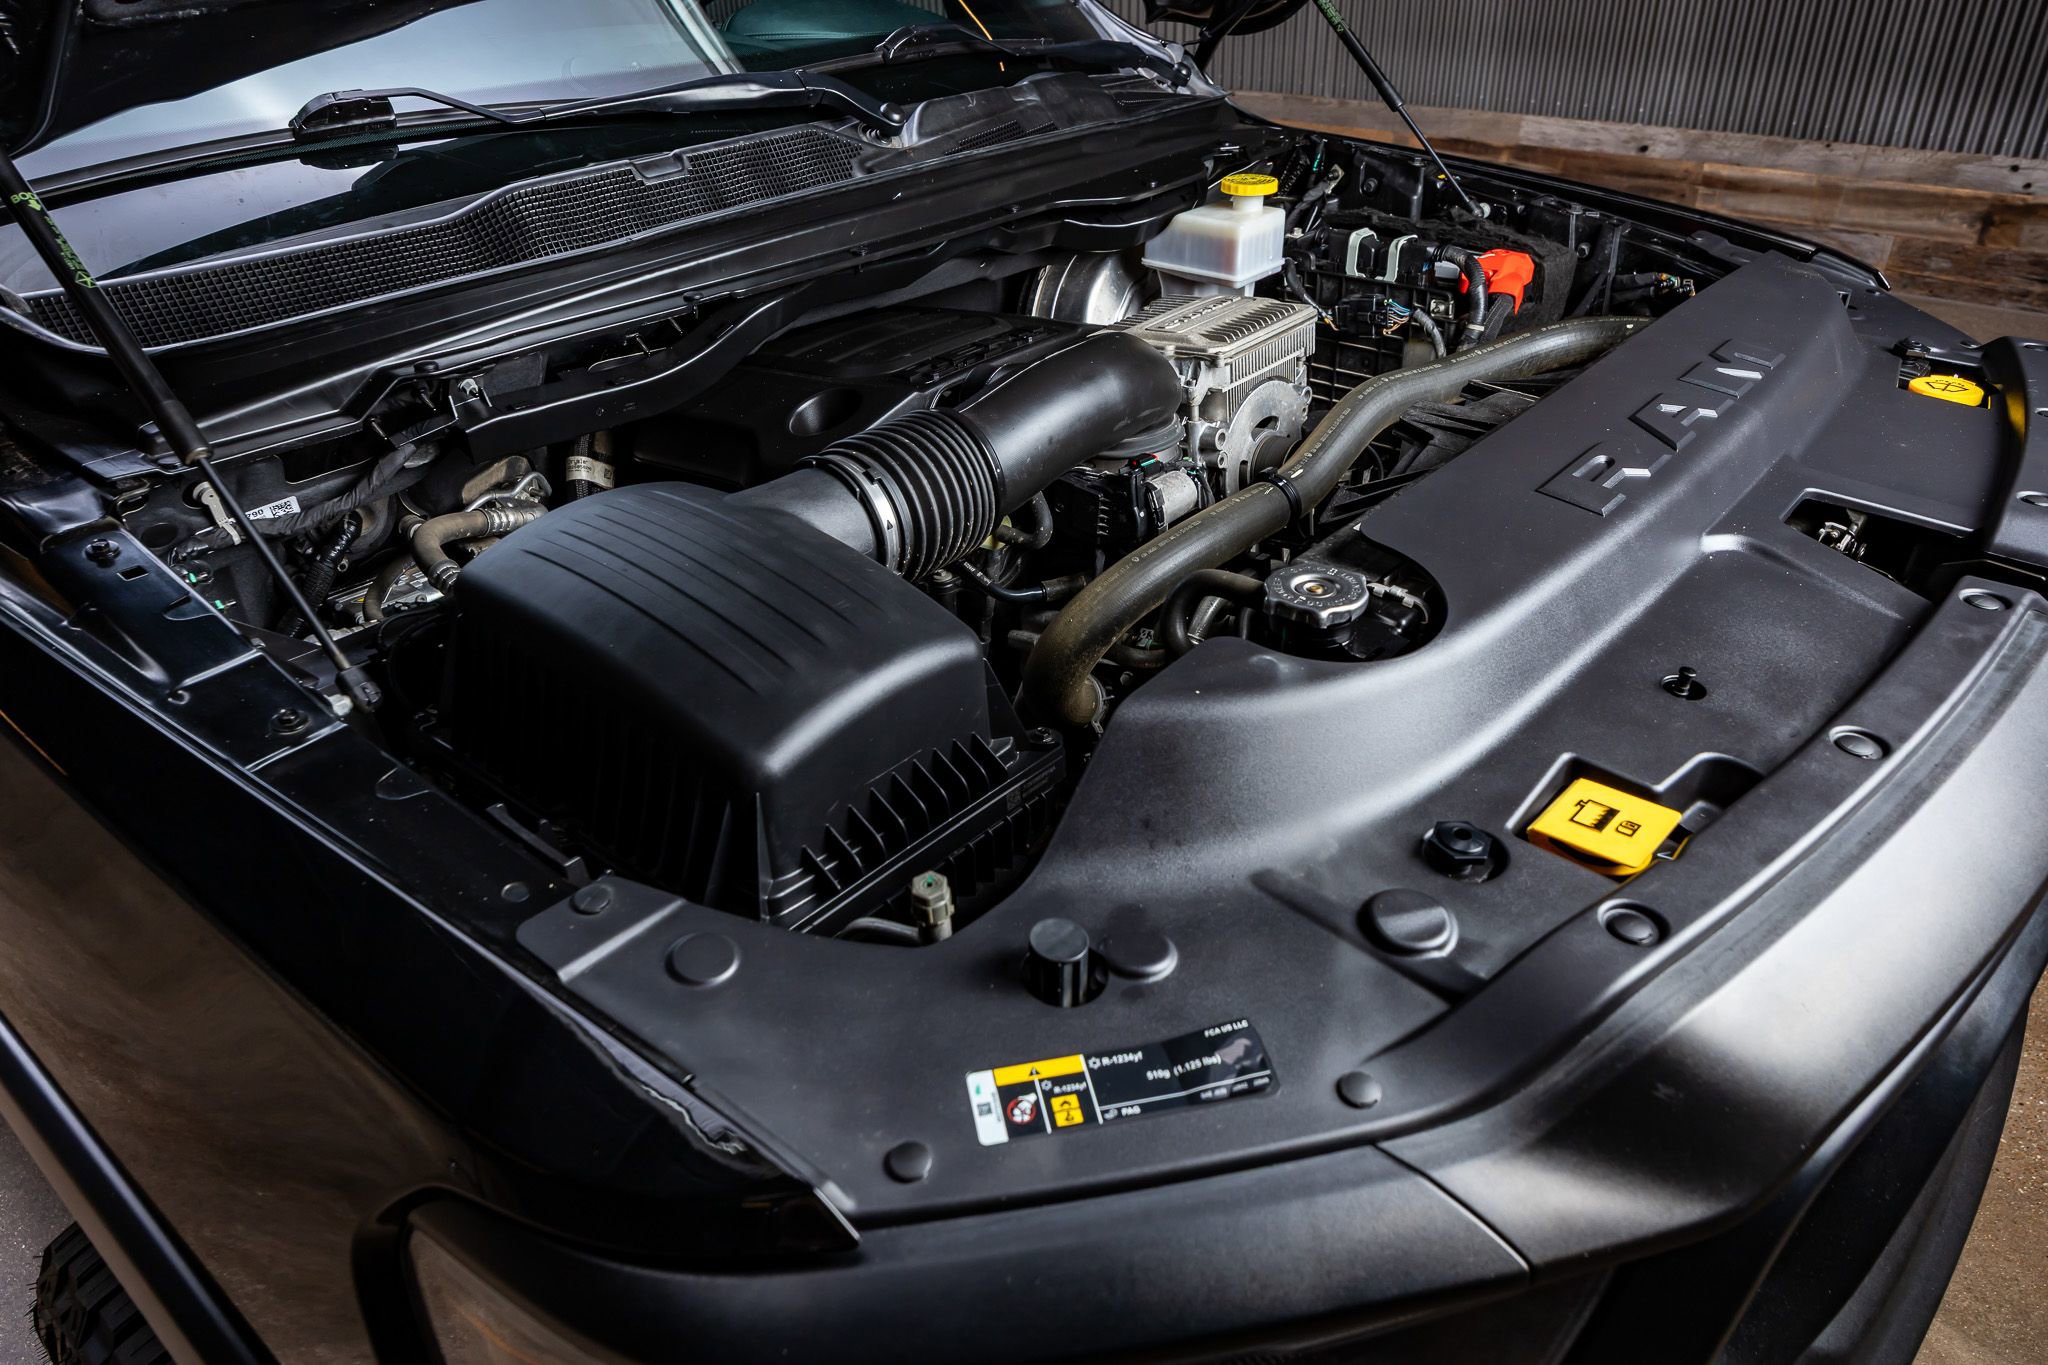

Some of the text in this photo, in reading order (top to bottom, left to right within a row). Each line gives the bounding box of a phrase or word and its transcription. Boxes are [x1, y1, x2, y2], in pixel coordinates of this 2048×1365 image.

[1534, 338, 1787, 517] RAM
[1204, 1019, 1249, 1038] FCA US LLC
[1101, 1051, 1143, 1067] R-1234yf
[1173, 1059, 1202, 1077] (1.125
[1202, 1053, 1222, 1068] lbs)
[1121, 1105, 1141, 1117] PAG
